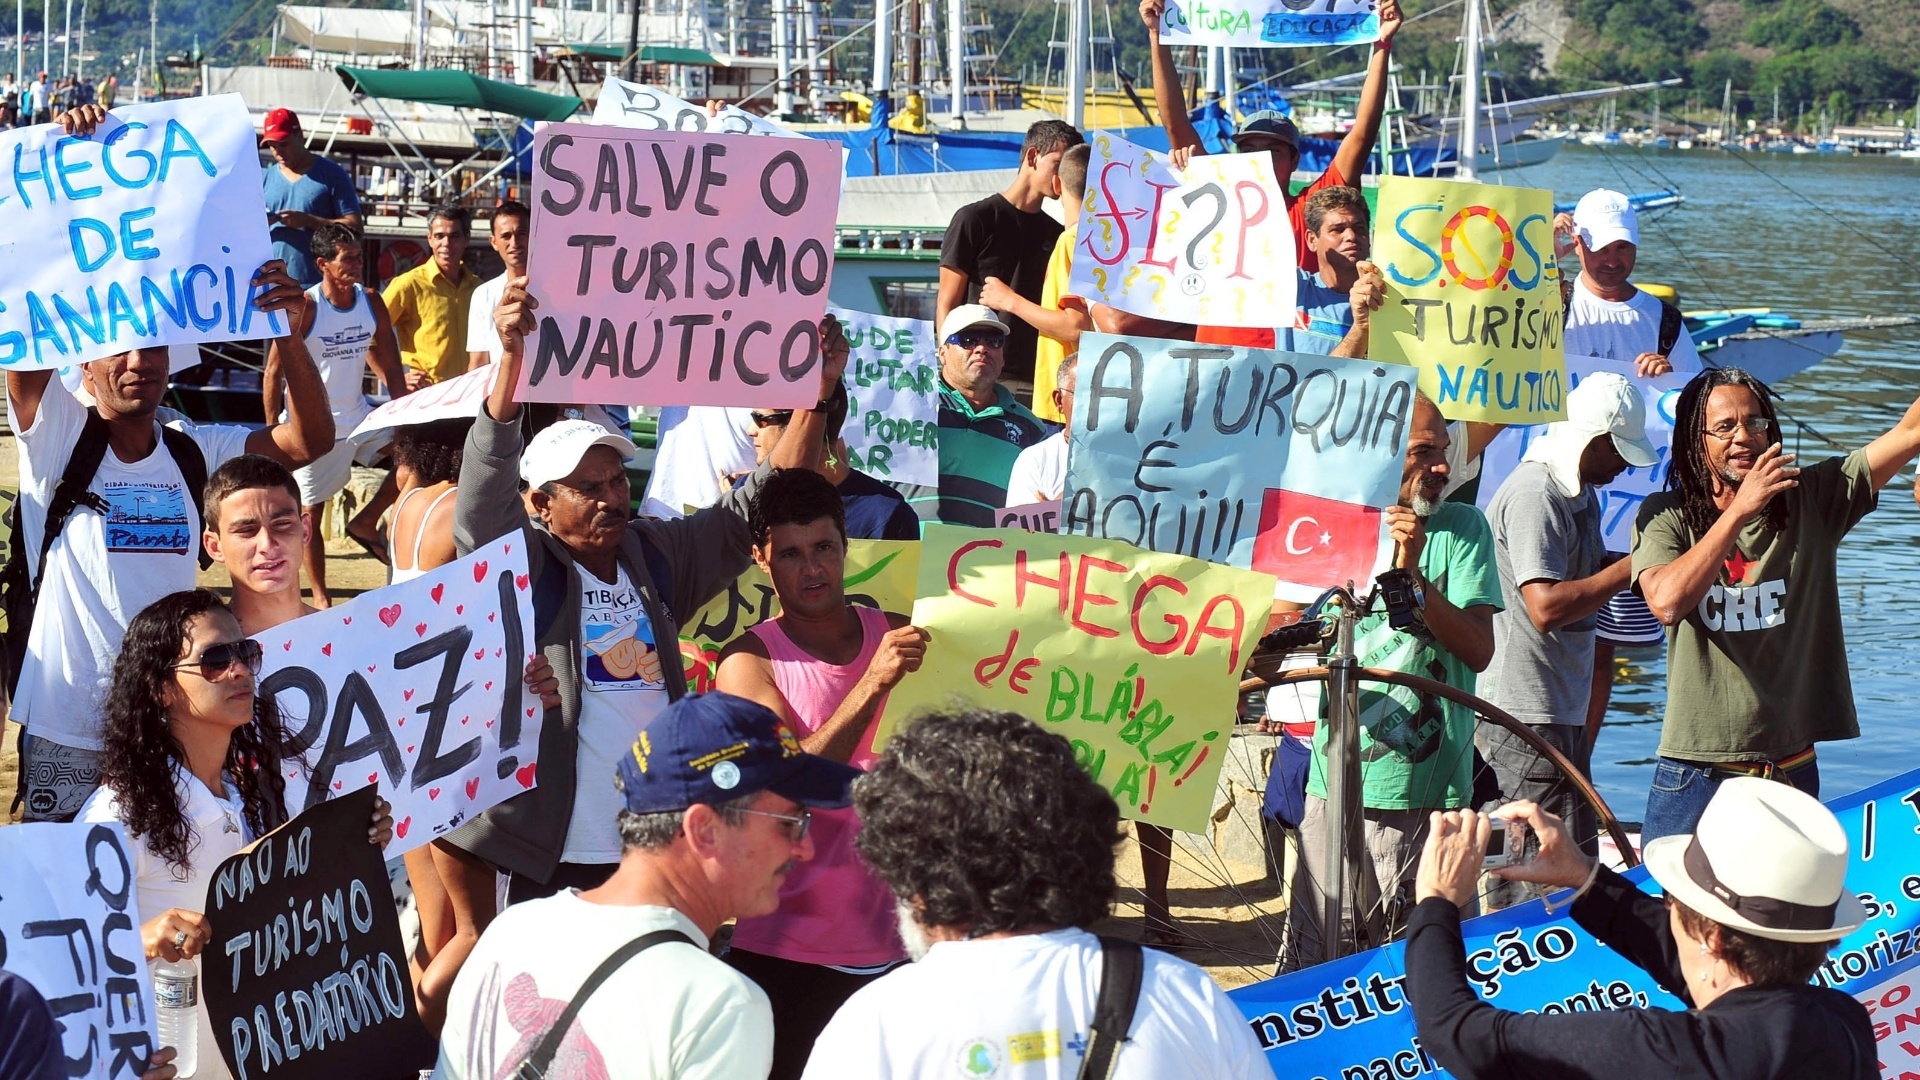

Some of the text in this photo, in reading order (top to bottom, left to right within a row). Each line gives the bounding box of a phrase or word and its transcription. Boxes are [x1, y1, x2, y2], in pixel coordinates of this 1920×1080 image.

[0, 118, 217, 209] HEGA
[541, 134, 809, 217] SALVE O
[69, 206, 160, 273] DE
[567, 235, 829, 301] TURISMO
[1401, 298, 1560, 350] TURISMO
[855, 358, 935, 397] LUTAR
[1086, 341, 1412, 459] A TURQUIA
[1437, 358, 1561, 413] NÁUTICO
[865, 410, 939, 451] PODER
[946, 539, 1245, 676] CHEGA
[1698, 579, 1787, 632] CHE
[284, 826, 312, 879] AO
[225, 879, 373, 993] TURISMO
